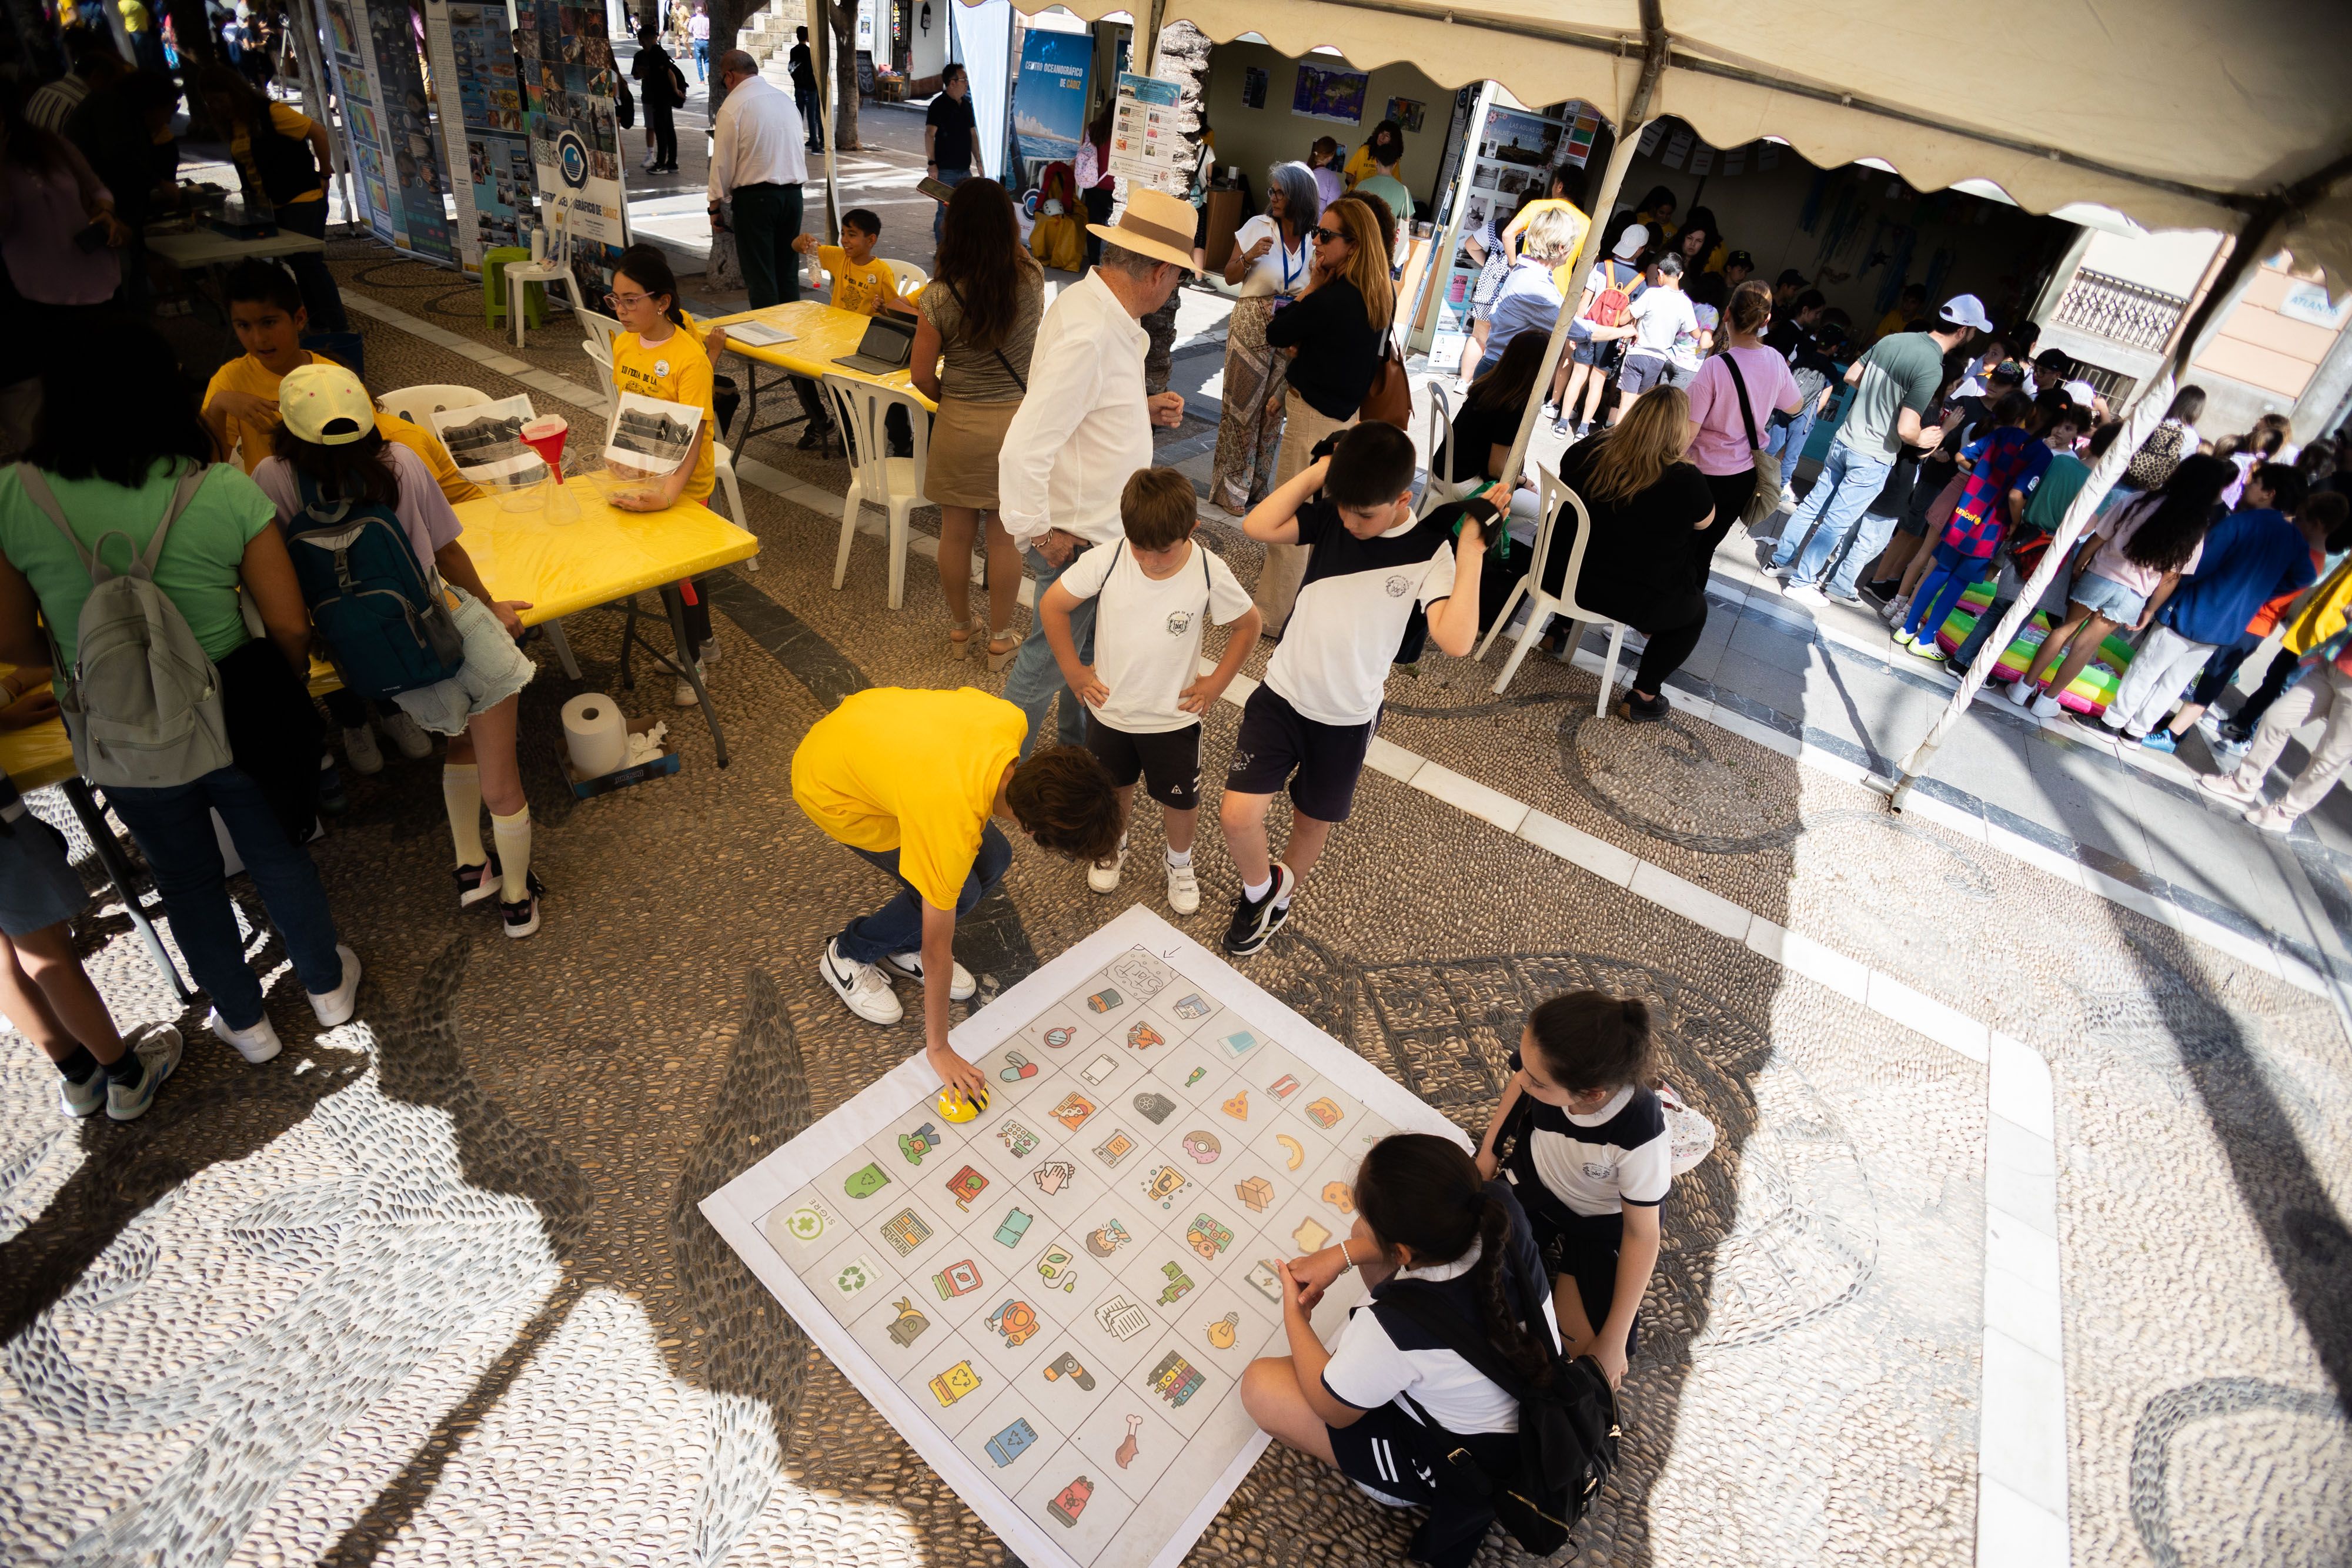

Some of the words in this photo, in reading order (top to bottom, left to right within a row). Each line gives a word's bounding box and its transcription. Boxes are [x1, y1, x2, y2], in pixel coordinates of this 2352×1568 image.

[1025, 61, 1043, 71] CENTRO
[1044, 63, 1083, 77] OCEANOGRÁFICO
[1060, 78, 1066, 87] DE
[1066, 78, 1081, 89] CÁDIZ
[643, 373, 650, 382] DE
[650, 376, 657, 386] LA
[1955, 507, 1977, 522] unicef
[1186, 1006, 1197, 1016] MILK
[809, 1199, 836, 1225] SIGRE
[888, 1233, 909, 1254] NEWS
